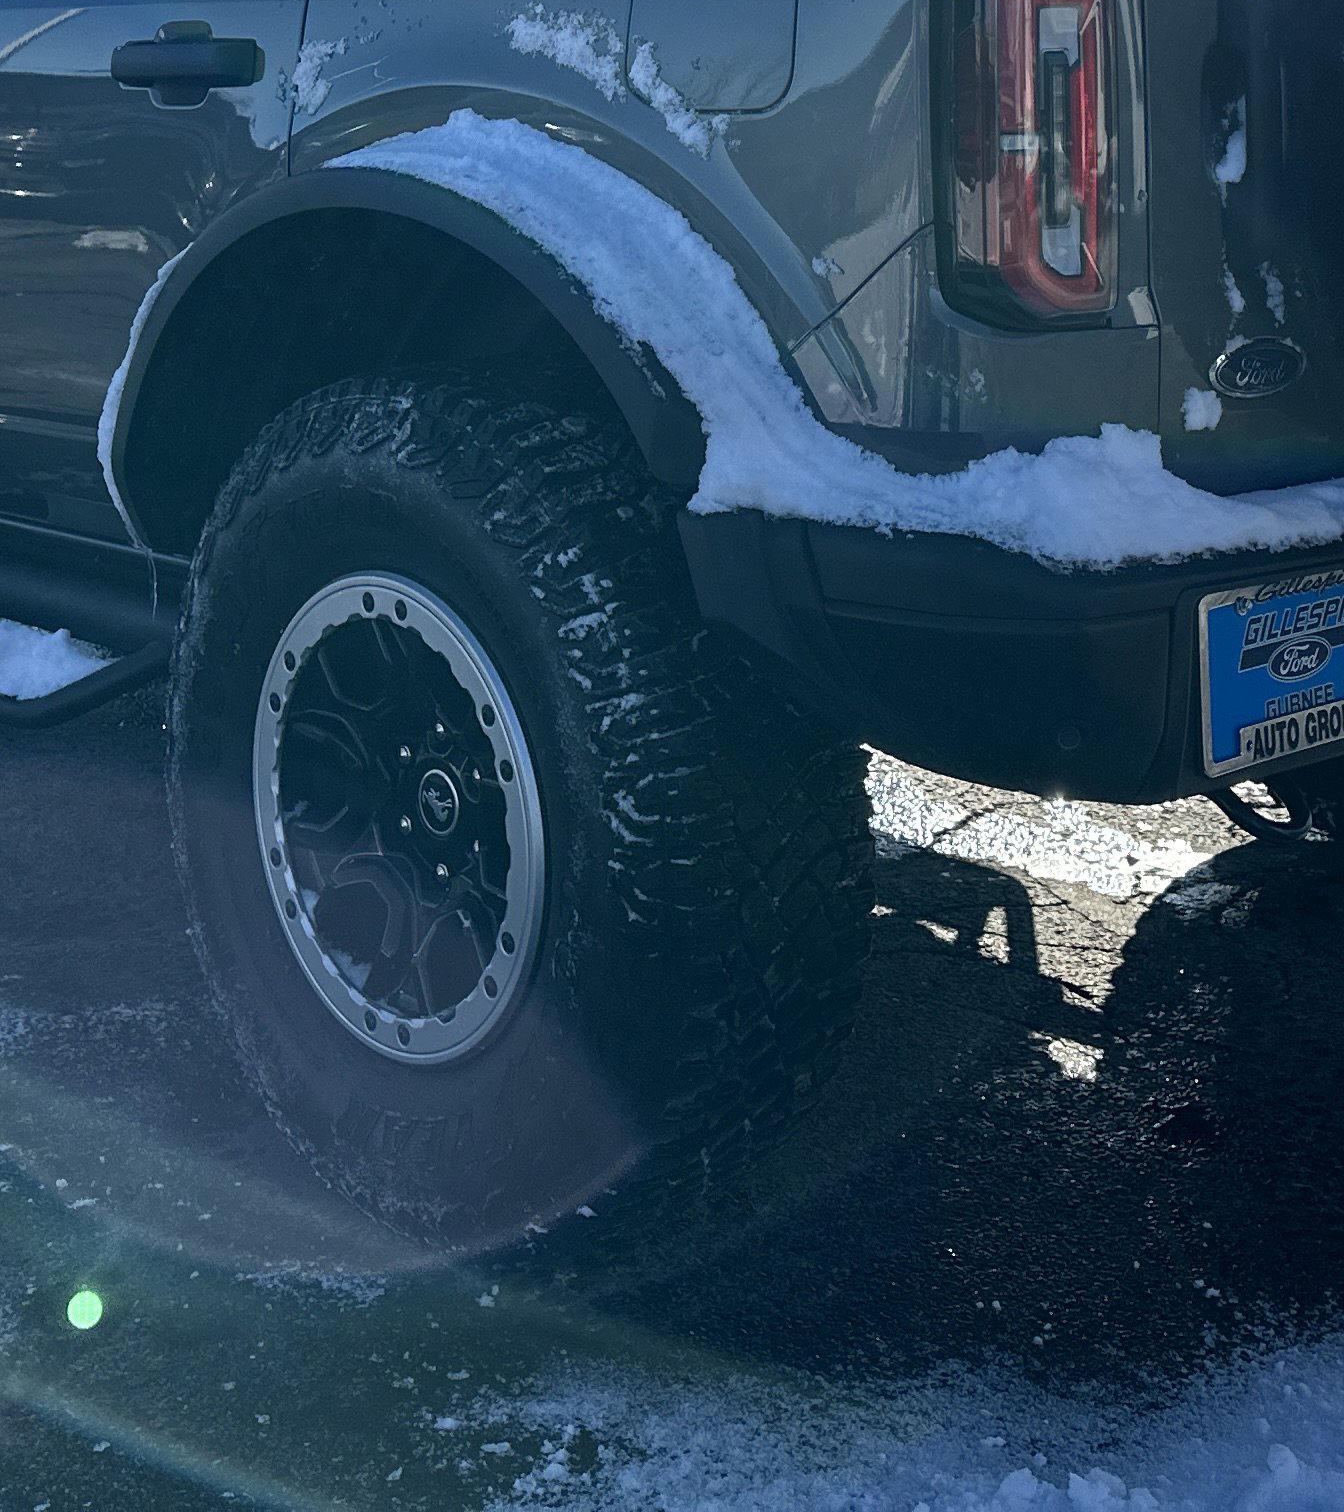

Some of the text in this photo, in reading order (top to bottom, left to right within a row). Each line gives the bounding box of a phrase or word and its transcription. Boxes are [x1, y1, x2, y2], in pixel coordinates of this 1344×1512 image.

[1236, 355, 1285, 387] Ford
[1280, 644, 1319, 675] Ford
[1265, 682, 1335, 718] GURNEE
[1253, 717, 1299, 761] AUTO
